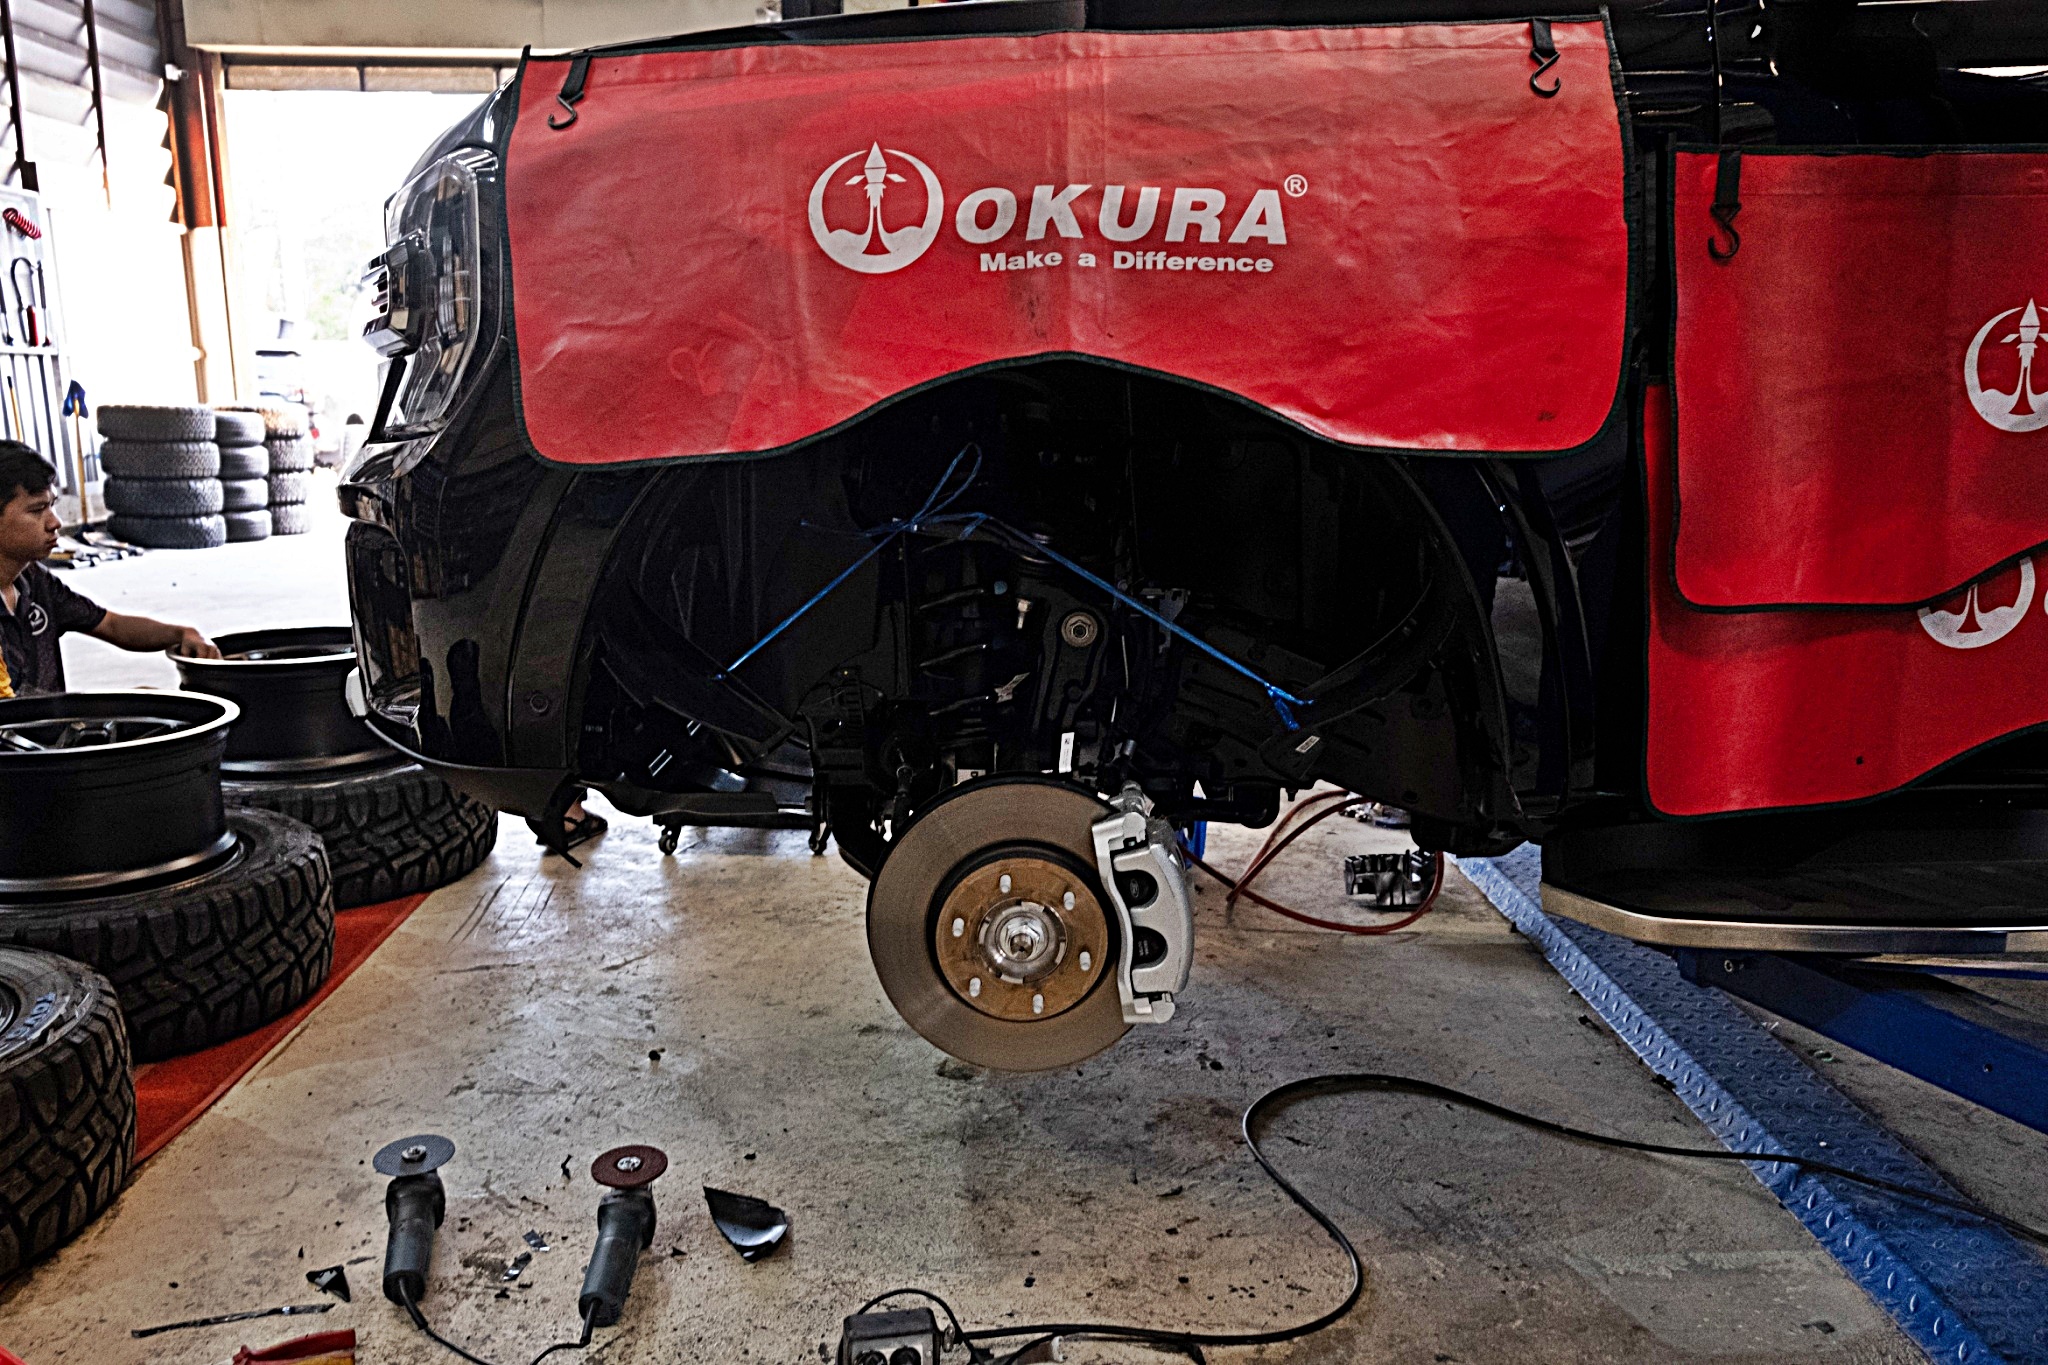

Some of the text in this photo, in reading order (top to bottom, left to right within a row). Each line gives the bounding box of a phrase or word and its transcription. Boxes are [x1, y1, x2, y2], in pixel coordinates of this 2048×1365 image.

[956, 184, 1288, 245] OKURA
[980, 250, 1274, 273] Make a Difference
